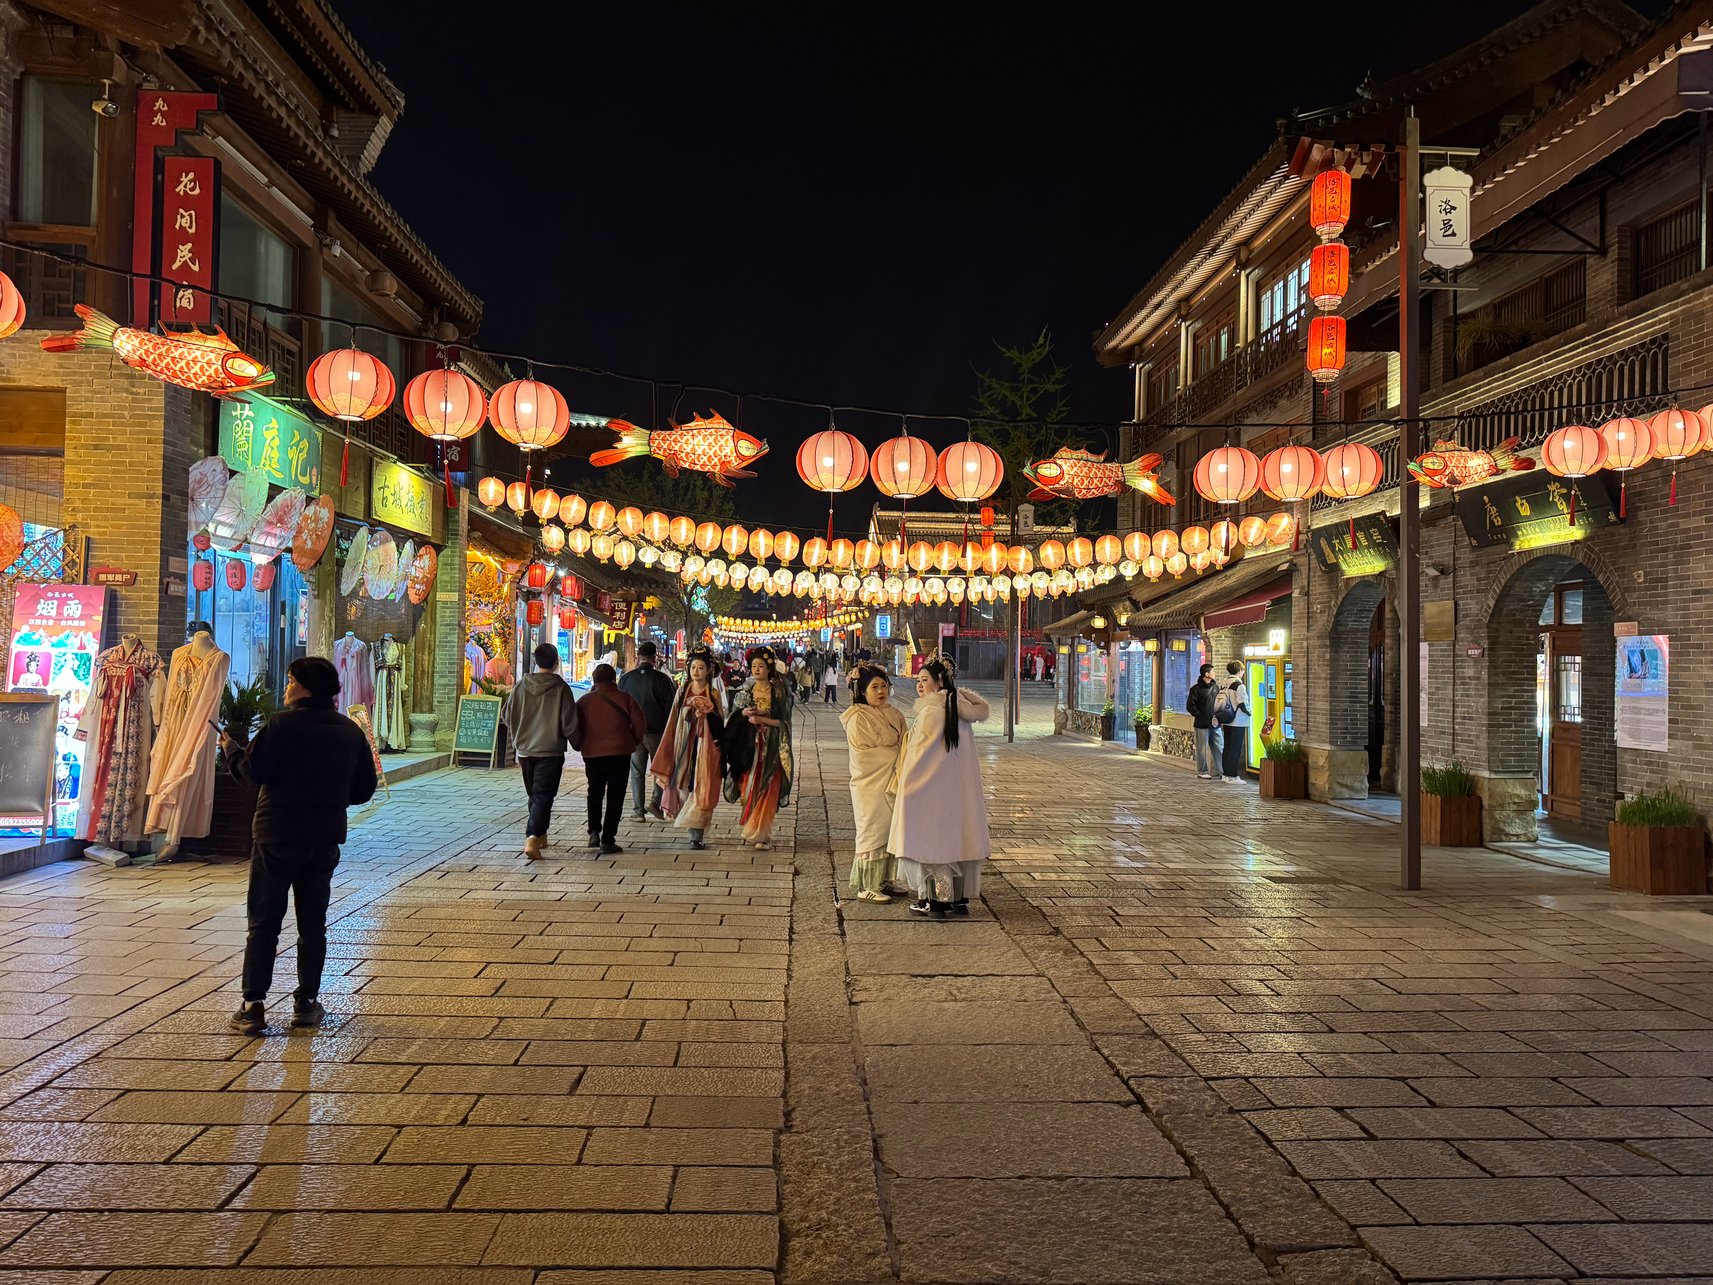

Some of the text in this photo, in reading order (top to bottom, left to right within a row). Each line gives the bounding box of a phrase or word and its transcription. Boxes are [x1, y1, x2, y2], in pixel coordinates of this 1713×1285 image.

[152, 97, 169, 126] 九九
[1438, 198, 1458, 238] 洛邑
[34, 598, 83, 619] 烟雨
[612, 601, 628, 629] 便利店
